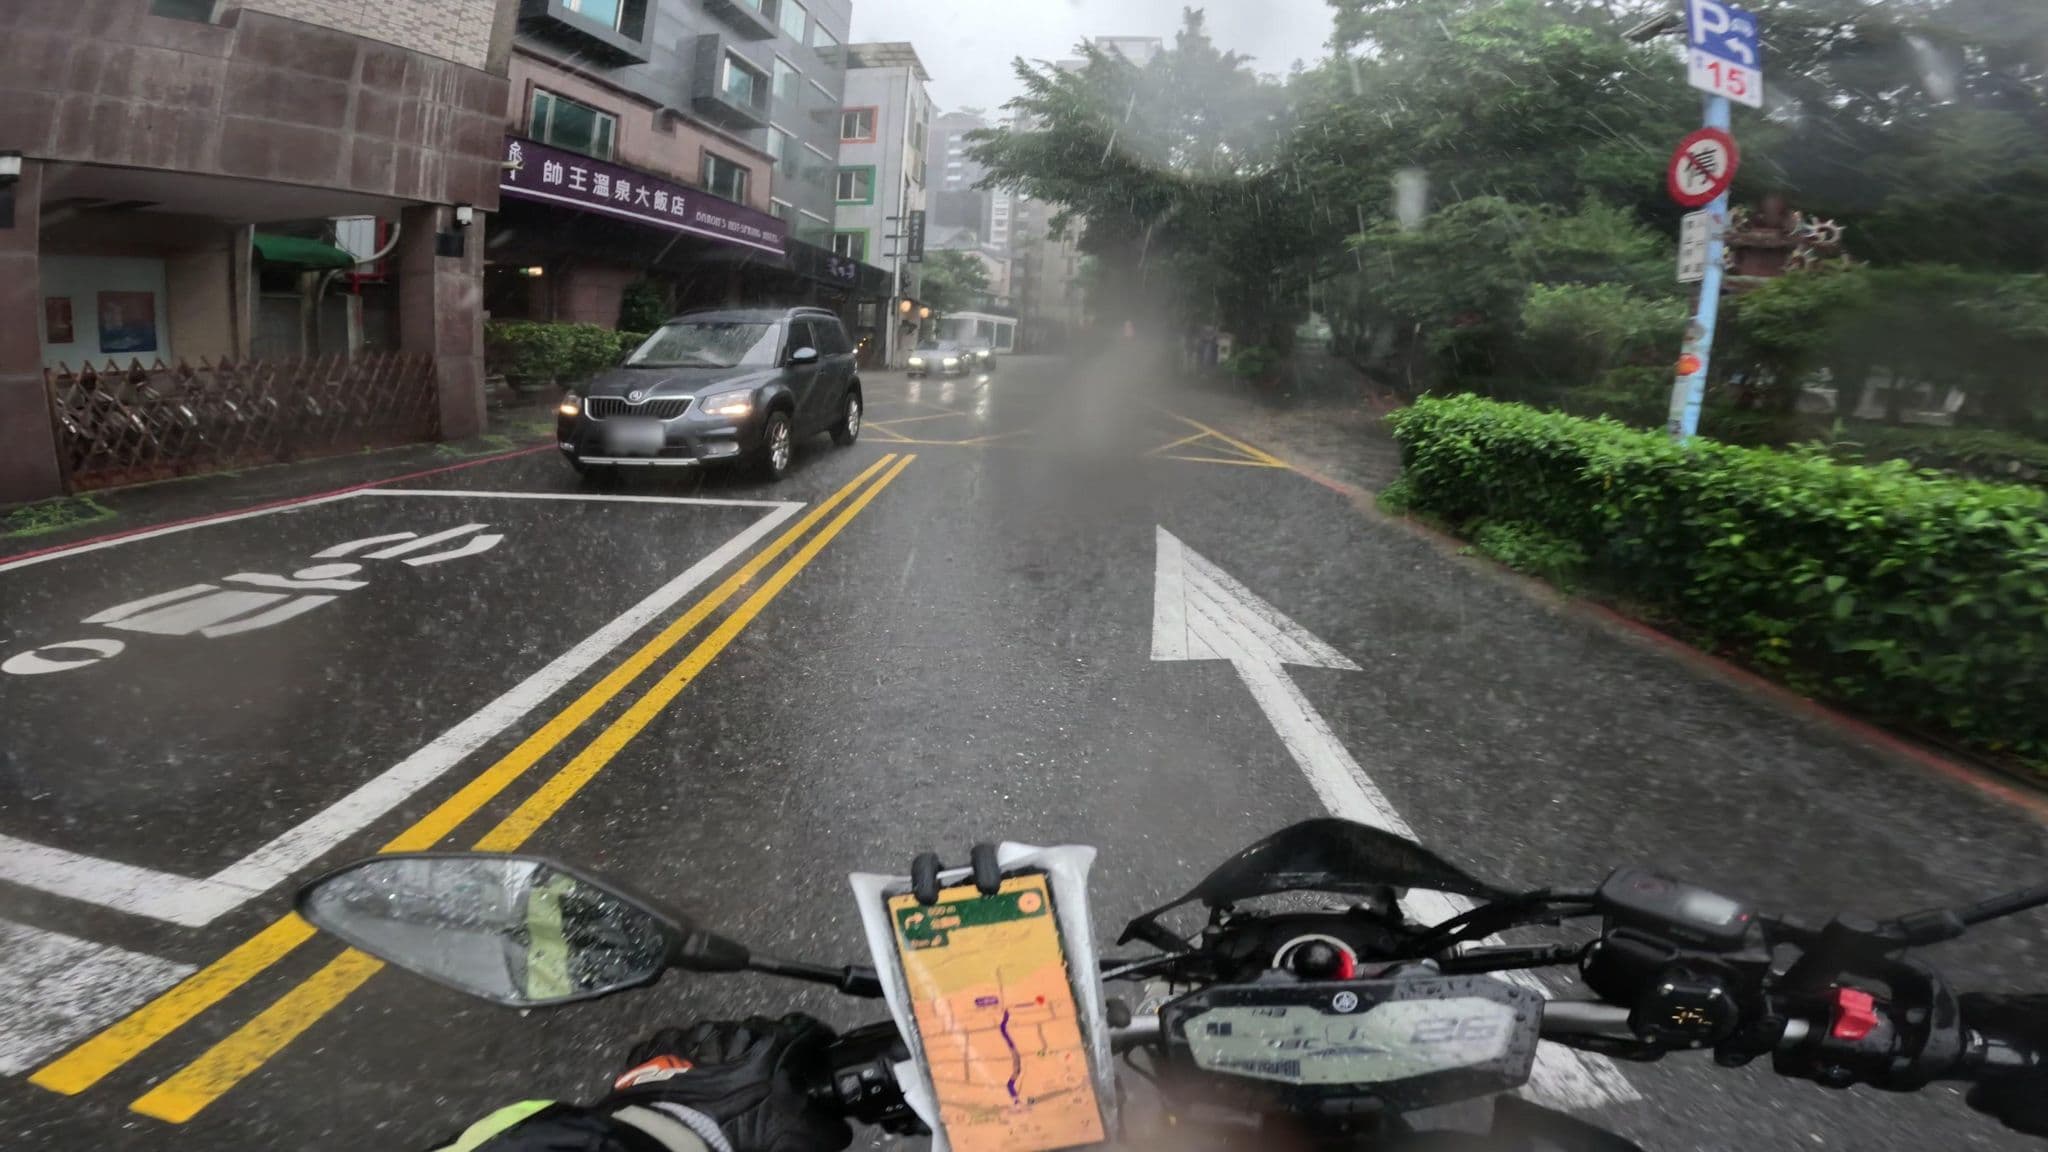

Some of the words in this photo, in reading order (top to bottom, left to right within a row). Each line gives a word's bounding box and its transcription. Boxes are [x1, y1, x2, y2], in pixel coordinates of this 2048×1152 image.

[1692, 0, 1730, 44] P
[1706, 61, 1747, 96] 15
[543, 159, 686, 217] 帥王溫泉大飯店
[1410, 1015, 1498, 1043] 26
